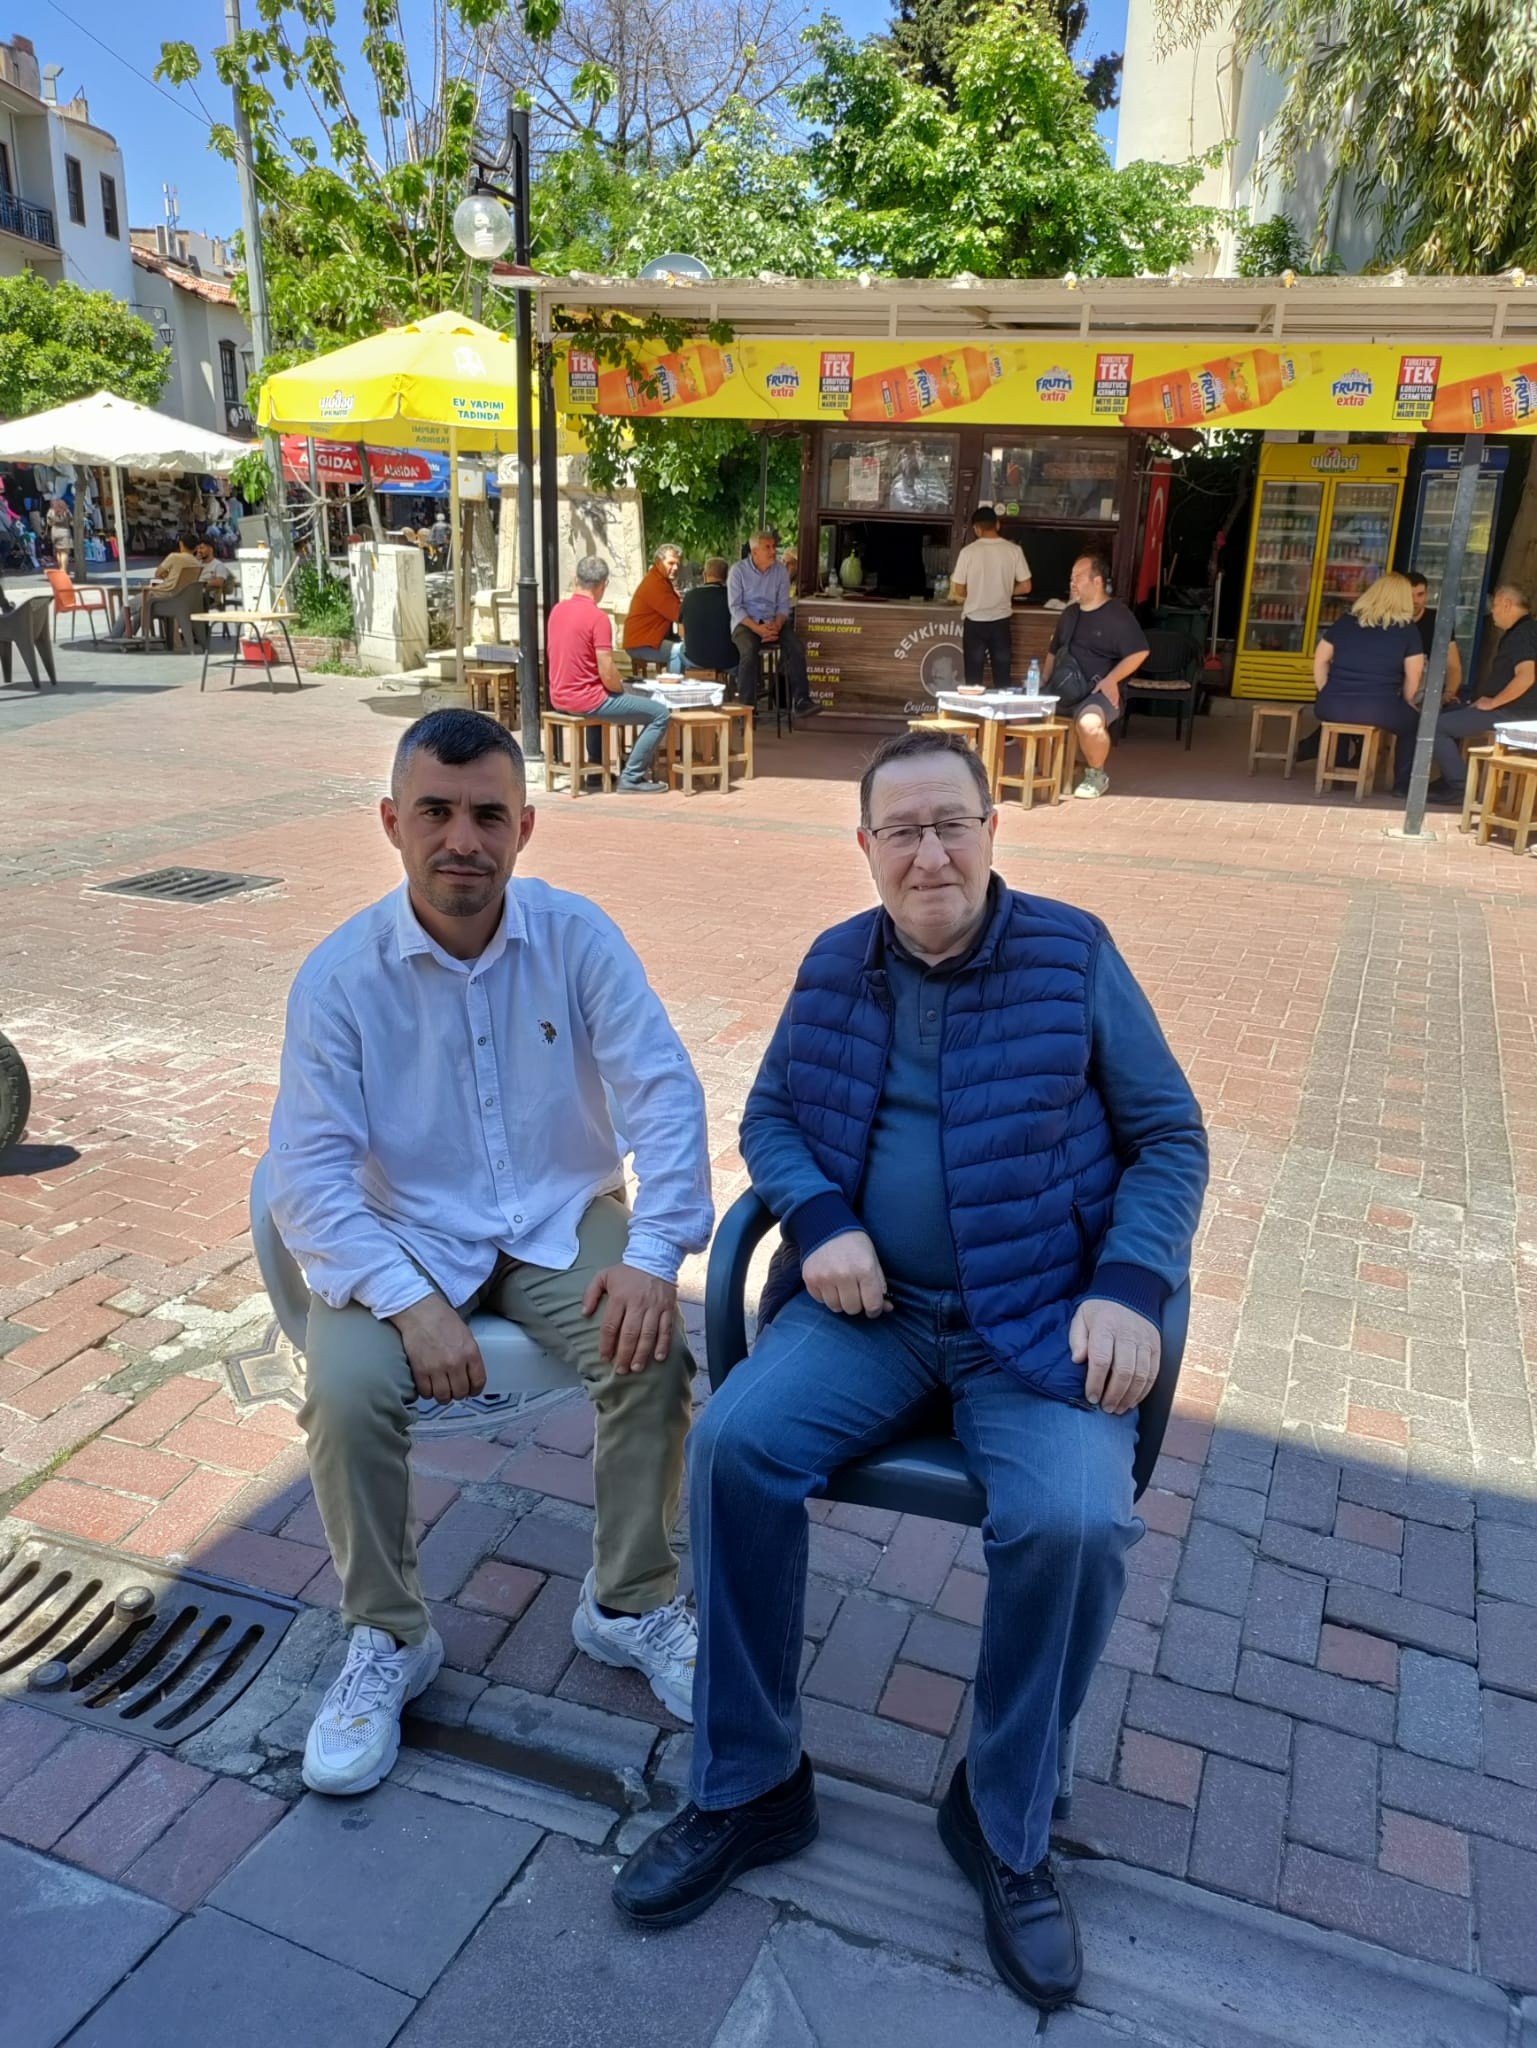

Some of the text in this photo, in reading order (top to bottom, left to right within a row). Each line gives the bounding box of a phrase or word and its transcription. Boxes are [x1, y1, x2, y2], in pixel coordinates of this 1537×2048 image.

[572, 357, 595, 372] TEK
[823, 361, 850, 377] TEK
[1100, 363, 1128, 380] TEK
[1403, 366, 1436, 384] TEK
[771, 387, 794, 397] extra
[1040, 391, 1066, 402] extra
[453, 398, 504, 410] EV YAPIMI
[1336, 395, 1365, 406] extra
[1502, 386, 1514, 416] extra
[458, 410, 500, 420] TADINDA
[299, 453, 355, 471] AGIDA
[1311, 454, 1359, 471] uludağ
[836, 626, 862, 634] COFFEE
